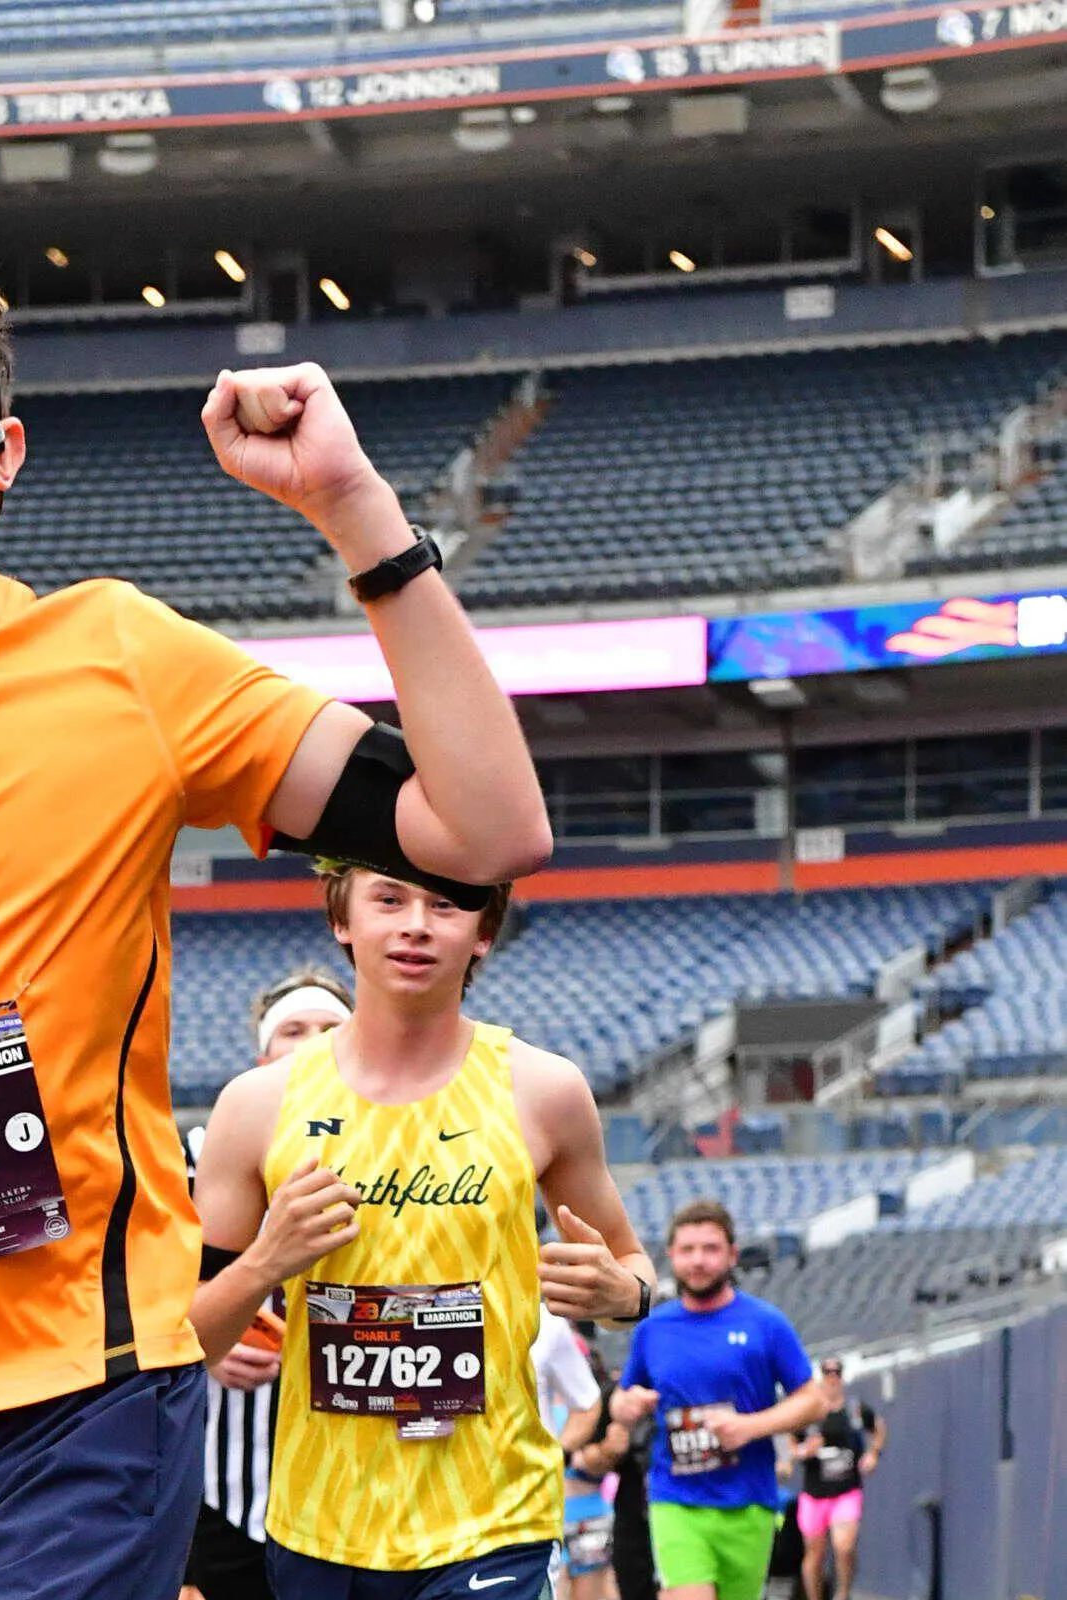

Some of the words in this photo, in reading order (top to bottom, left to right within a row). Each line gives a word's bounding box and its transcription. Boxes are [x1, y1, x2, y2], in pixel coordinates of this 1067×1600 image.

[980, 9, 1005, 40] 7
[1009, 2, 1067, 35] MO
[309, 77, 344, 107] 12
[346, 65, 501, 105] JOHNSON
[17, 90, 171, 123] TRIPUCKA
[19, 1122, 30, 1142] J
[306, 1118, 345, 1136] N
[330, 1164, 493, 1217] rthfield
[423, 1311, 477, 1323] MARATHON
[354, 1330, 401, 1342] CHARLIE
[322, 1343, 442, 1388] 12762
